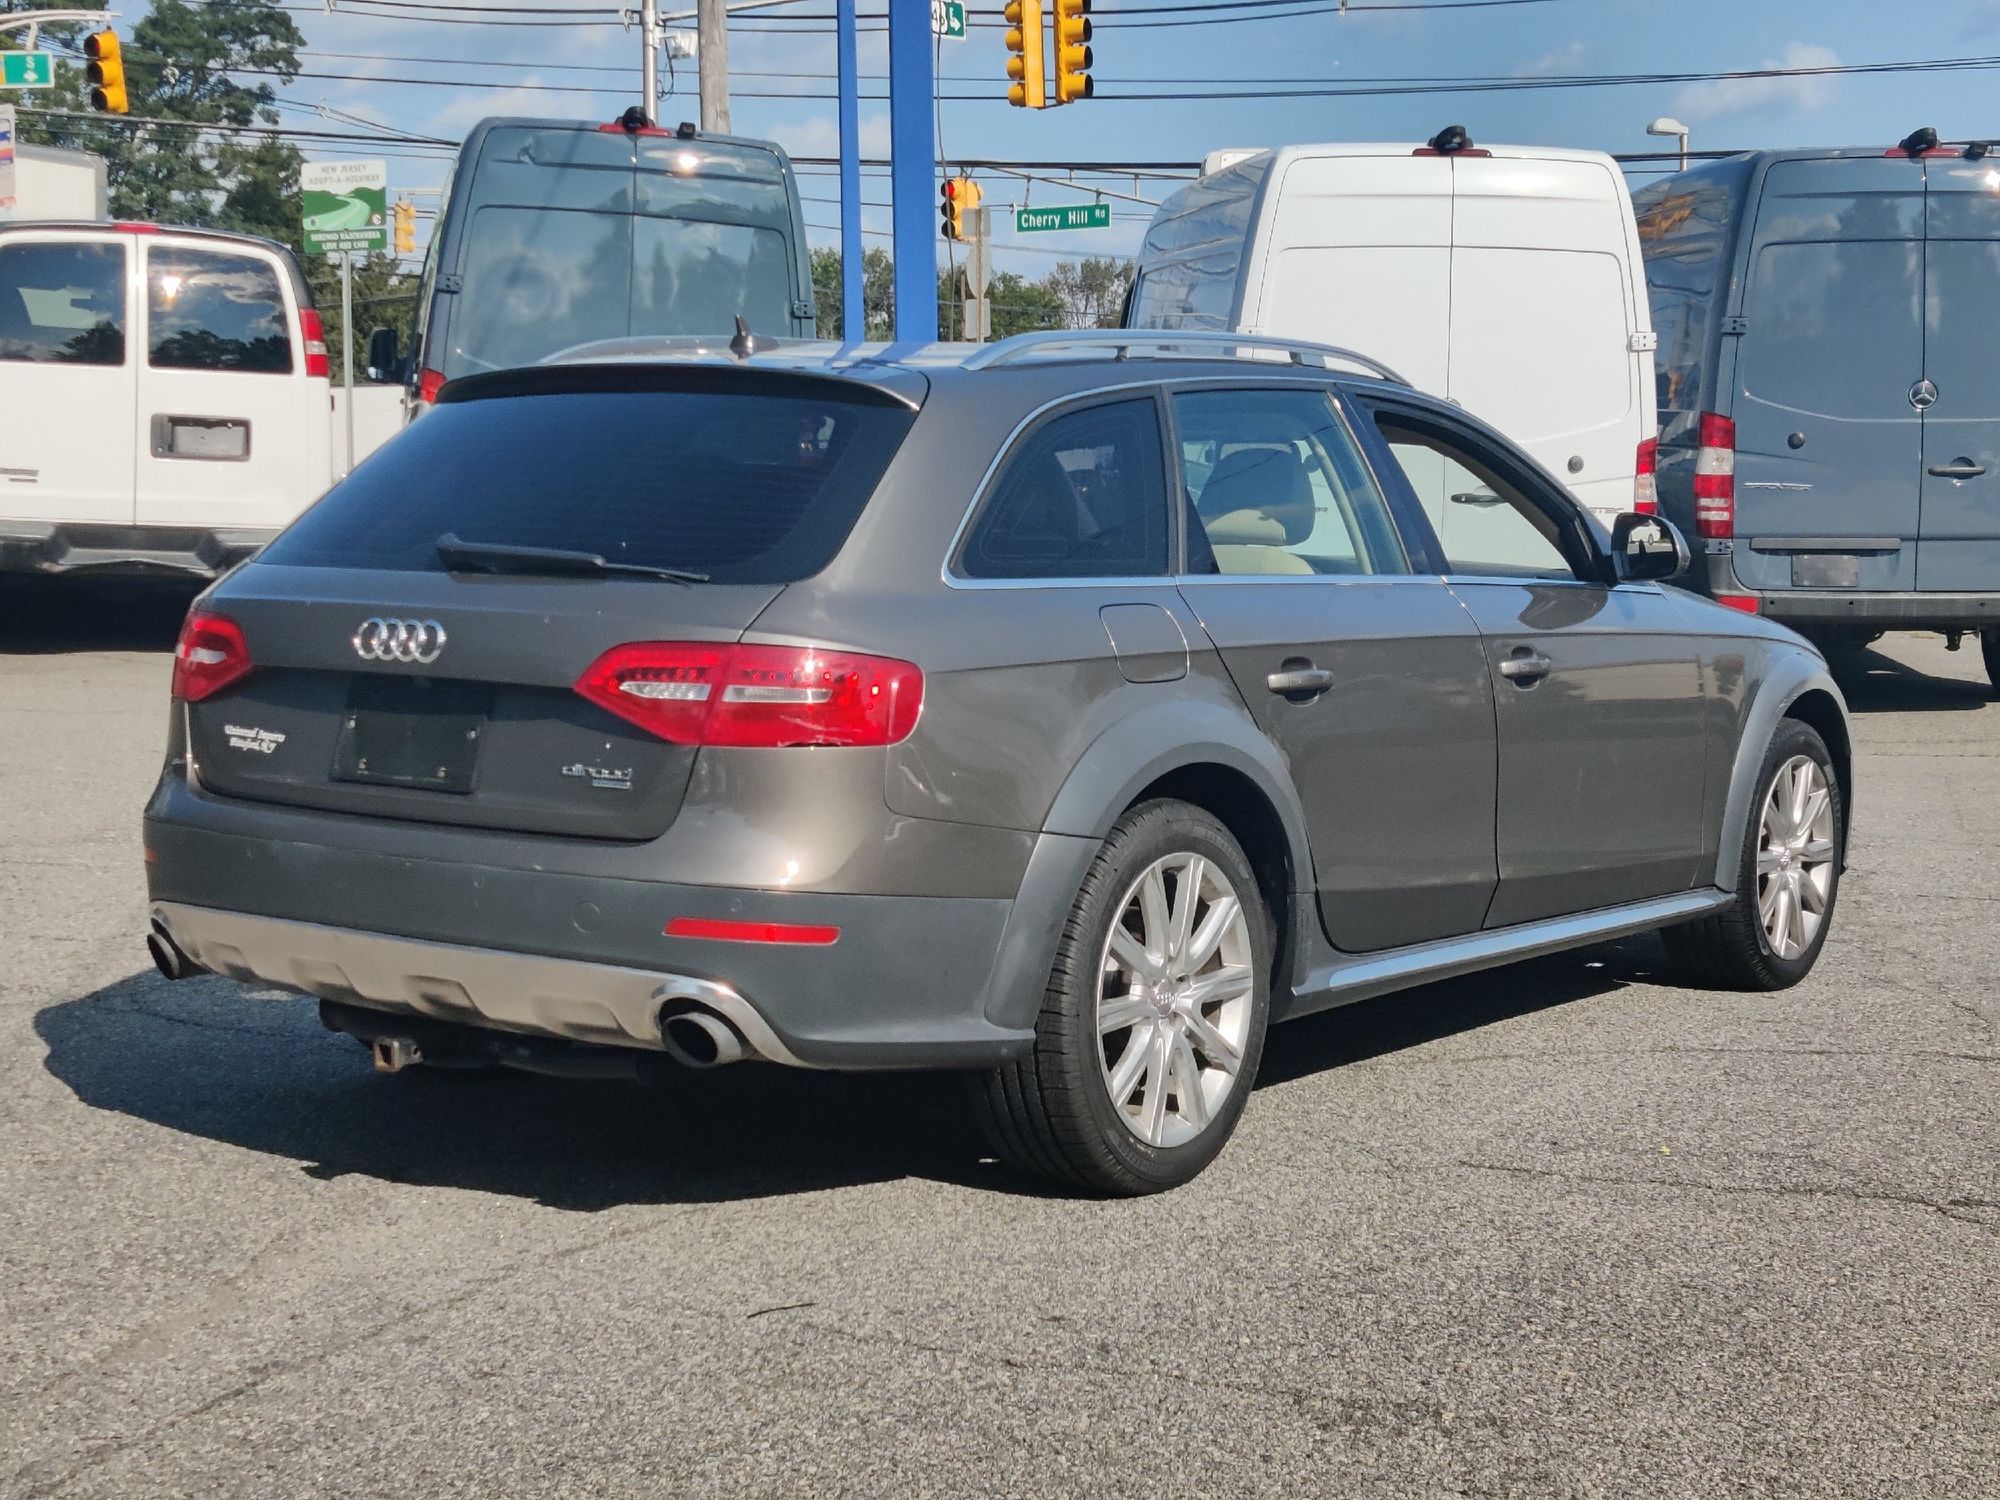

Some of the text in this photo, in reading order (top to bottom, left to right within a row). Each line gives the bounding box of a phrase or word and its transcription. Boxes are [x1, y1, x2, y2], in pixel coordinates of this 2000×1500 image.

[26, 55, 35, 69] S
[321, 164, 367, 174] NEW JERSEY
[309, 175, 380, 185] ADOPT-A-HIGHWAY
[1021, 208, 1105, 229] Cherry Hill Rd
